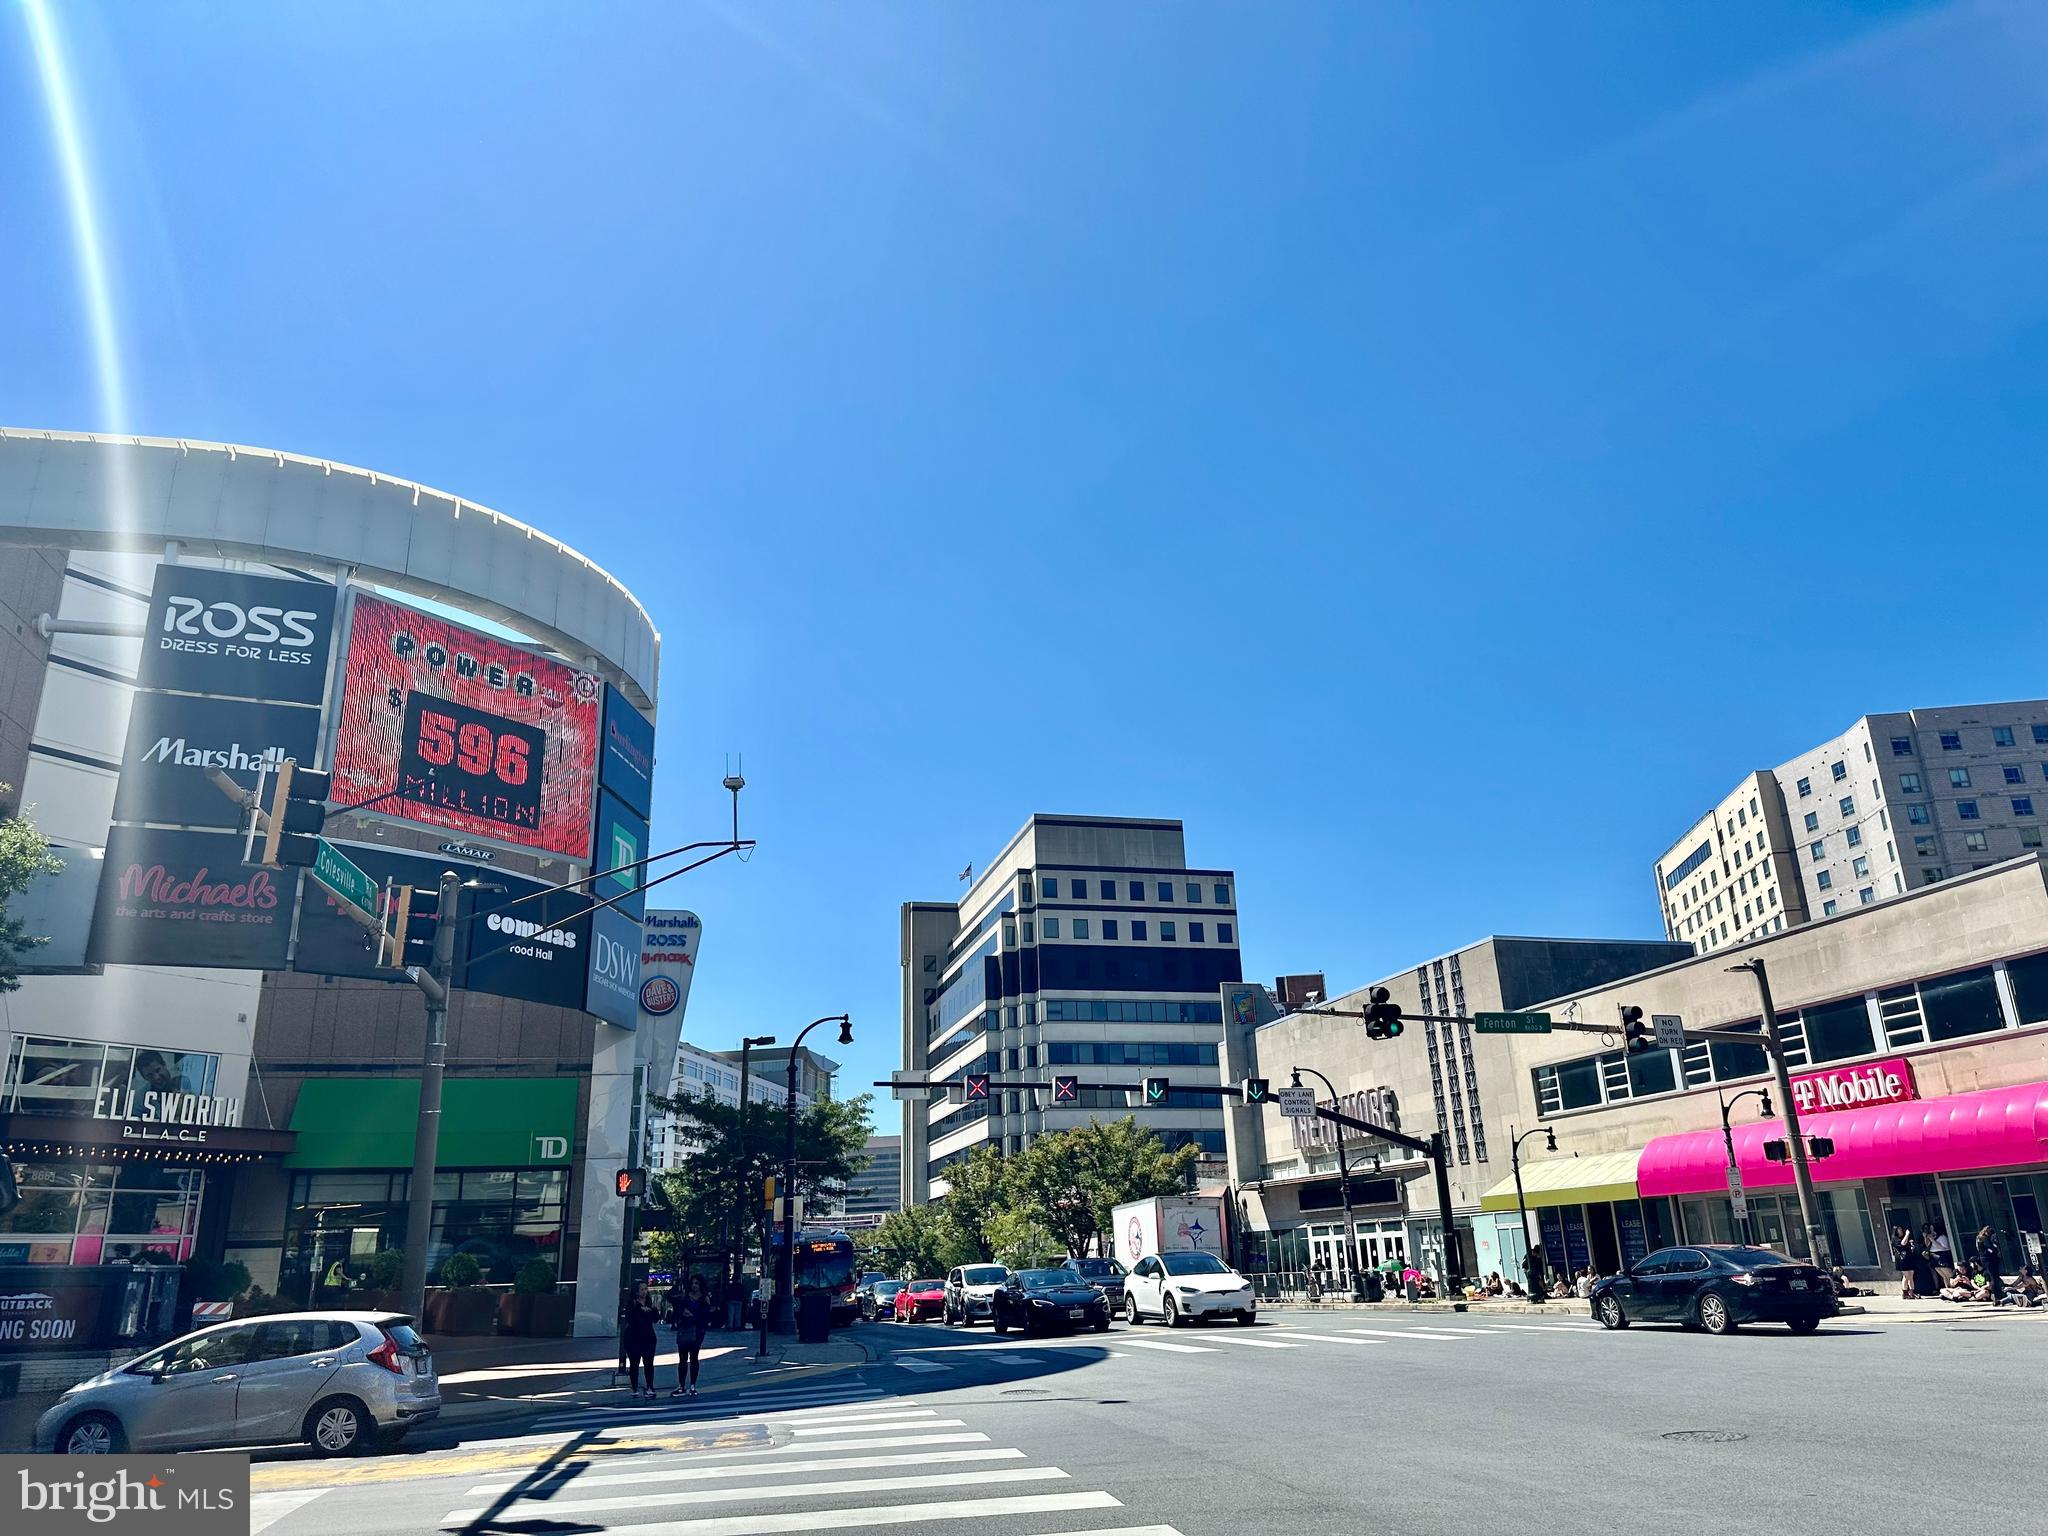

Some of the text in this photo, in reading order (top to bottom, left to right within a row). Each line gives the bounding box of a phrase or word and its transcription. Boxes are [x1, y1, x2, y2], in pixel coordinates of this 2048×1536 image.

[163, 595, 318, 647] ROSS
[160, 638, 312, 665] DRESS FOR LESS
[392, 633, 536, 696] POWER
[417, 709, 530, 786] 596
[405, 774, 535, 825] MILLION
[446, 844, 490, 859] LAMAR
[320, 850, 355, 894] Colesville
[119, 863, 278, 909] Michaels
[115, 906, 273, 924] the arts and crafts store
[645, 915, 699, 928] Marshalls
[646, 934, 687, 947] ROSS
[535, 947, 553, 961] Hall
[594, 932, 637, 987] DSW
[645, 984, 667, 998] DAVE
[1483, 1015, 1535, 1029] Fenton St
[1661, 1019, 1673, 1027] NO
[1660, 1028, 1679, 1036] TURN
[1659, 1036, 1669, 1044] ON
[93, 1087, 240, 1128] ELLSWORTH
[1285, 1106, 1312, 1114] SIGNALS
[123, 1126, 208, 1142] PLACE
[535, 1136, 568, 1159] TD
[1566, 1222, 1584, 1231] LEASE
[1621, 1219, 1642, 1228] LEASE
[0, 1299, 53, 1310] UTBACK
[29, 1319, 76, 1339] SOON
